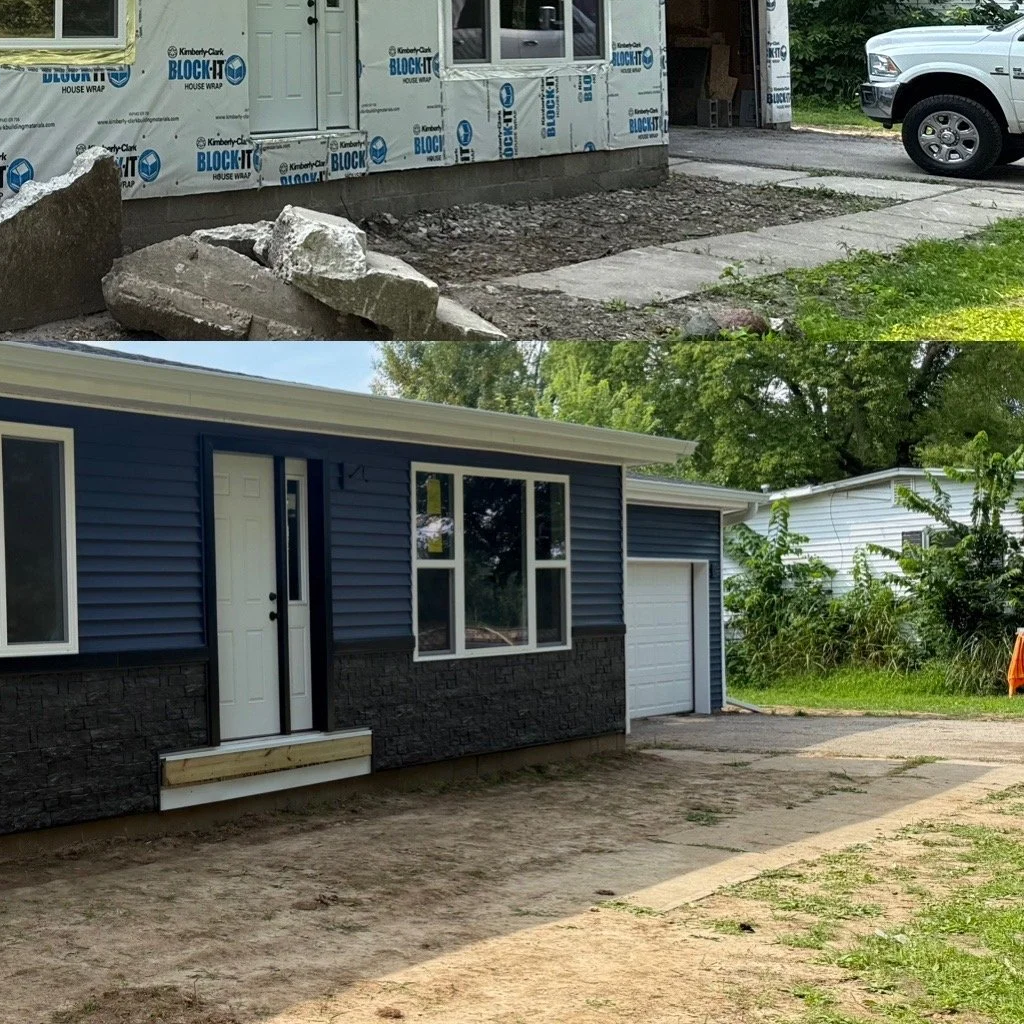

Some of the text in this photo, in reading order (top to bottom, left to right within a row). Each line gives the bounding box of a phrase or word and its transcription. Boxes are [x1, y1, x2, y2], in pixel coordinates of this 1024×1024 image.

[179, 47, 224, 58] Kimberly-Clark
[397, 47, 432, 57] Kimberly-Clark
[168, 59, 225, 81] BLOCK-IT
[389, 57, 433, 77] BLOCK-IT
[61, 84, 105, 94] HOUSE WRAP
[184, 82, 223, 91] HOUSE WRAP
[629, 116, 659, 134] BLOCK-IT
[196, 149, 253, 172] BLOCK-IT
[212, 172, 252, 181] HOUSE WRAP
